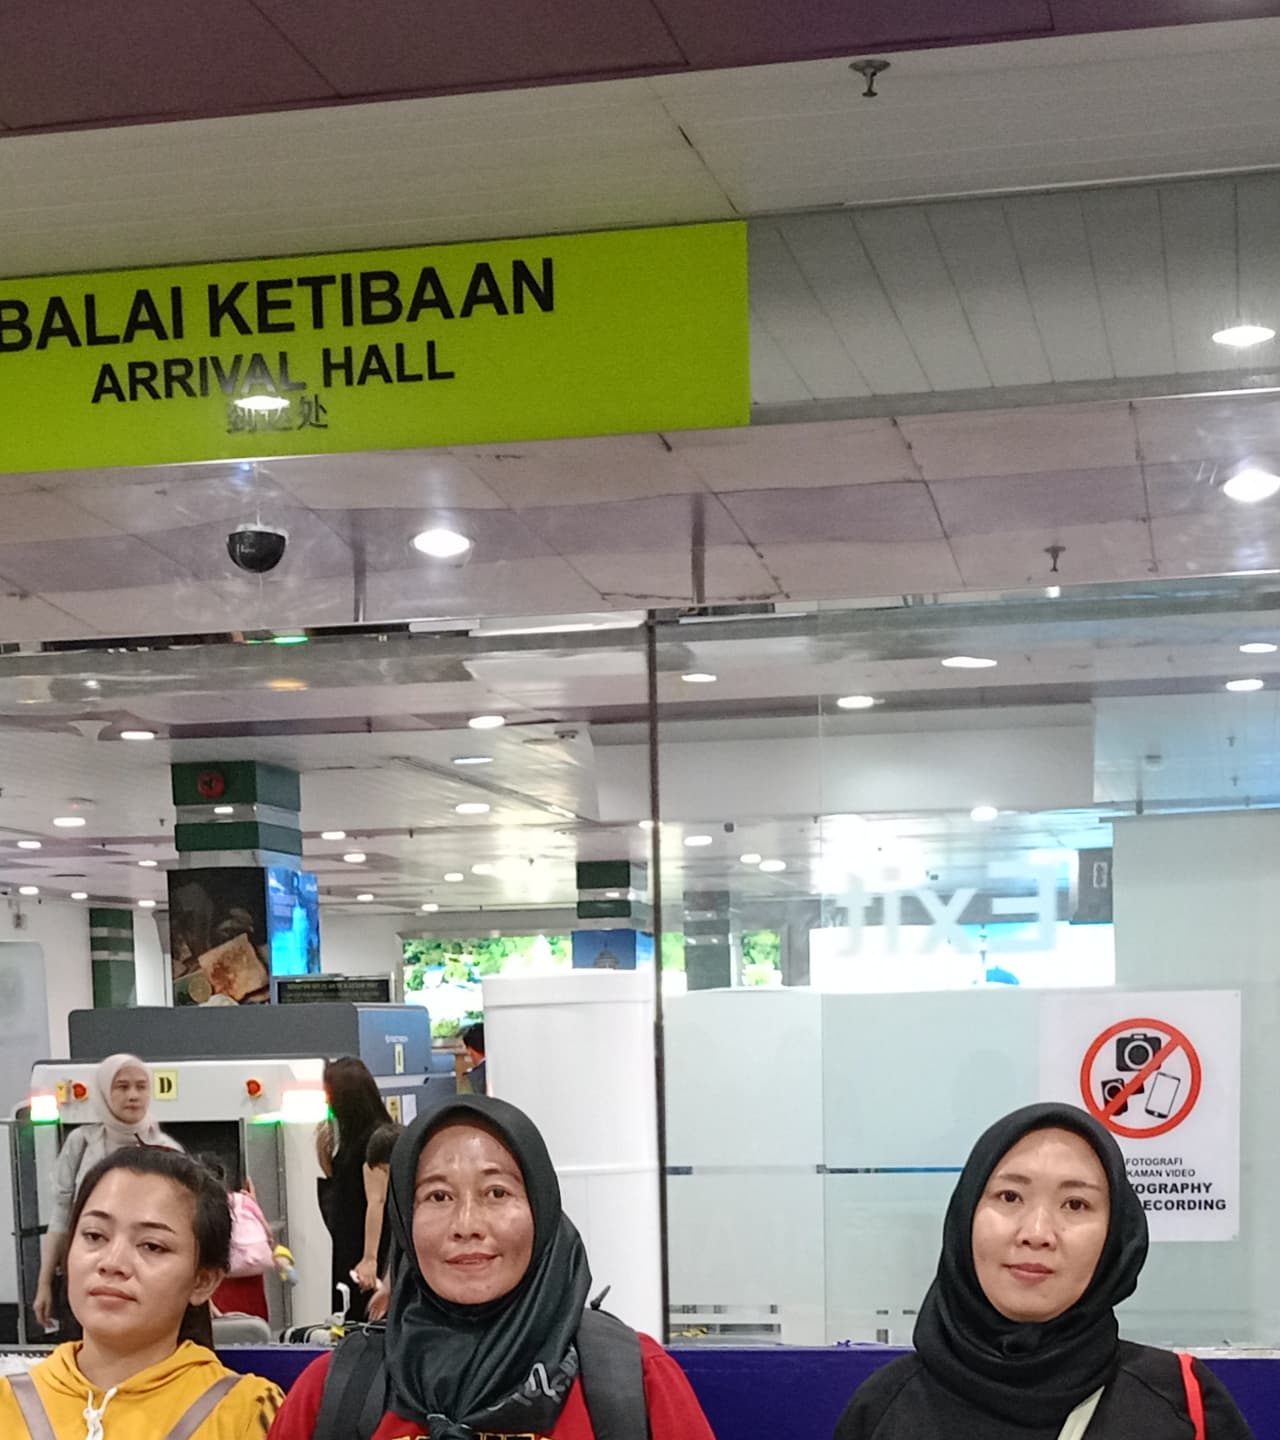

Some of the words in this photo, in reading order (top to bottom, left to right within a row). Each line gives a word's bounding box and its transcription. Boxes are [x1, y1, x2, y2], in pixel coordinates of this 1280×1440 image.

[207, 257, 556, 339] KETIBAAN
[91, 351, 307, 404] ARRIVAL
[321, 340, 455, 387] HALL
[1127, 1169, 1162, 1178] KAMAN
[1165, 1168, 1196, 1177] VIDEO
[1131, 1182, 1213, 1194] OGRAPHY
[1143, 1199, 1227, 1211] ECORDING
